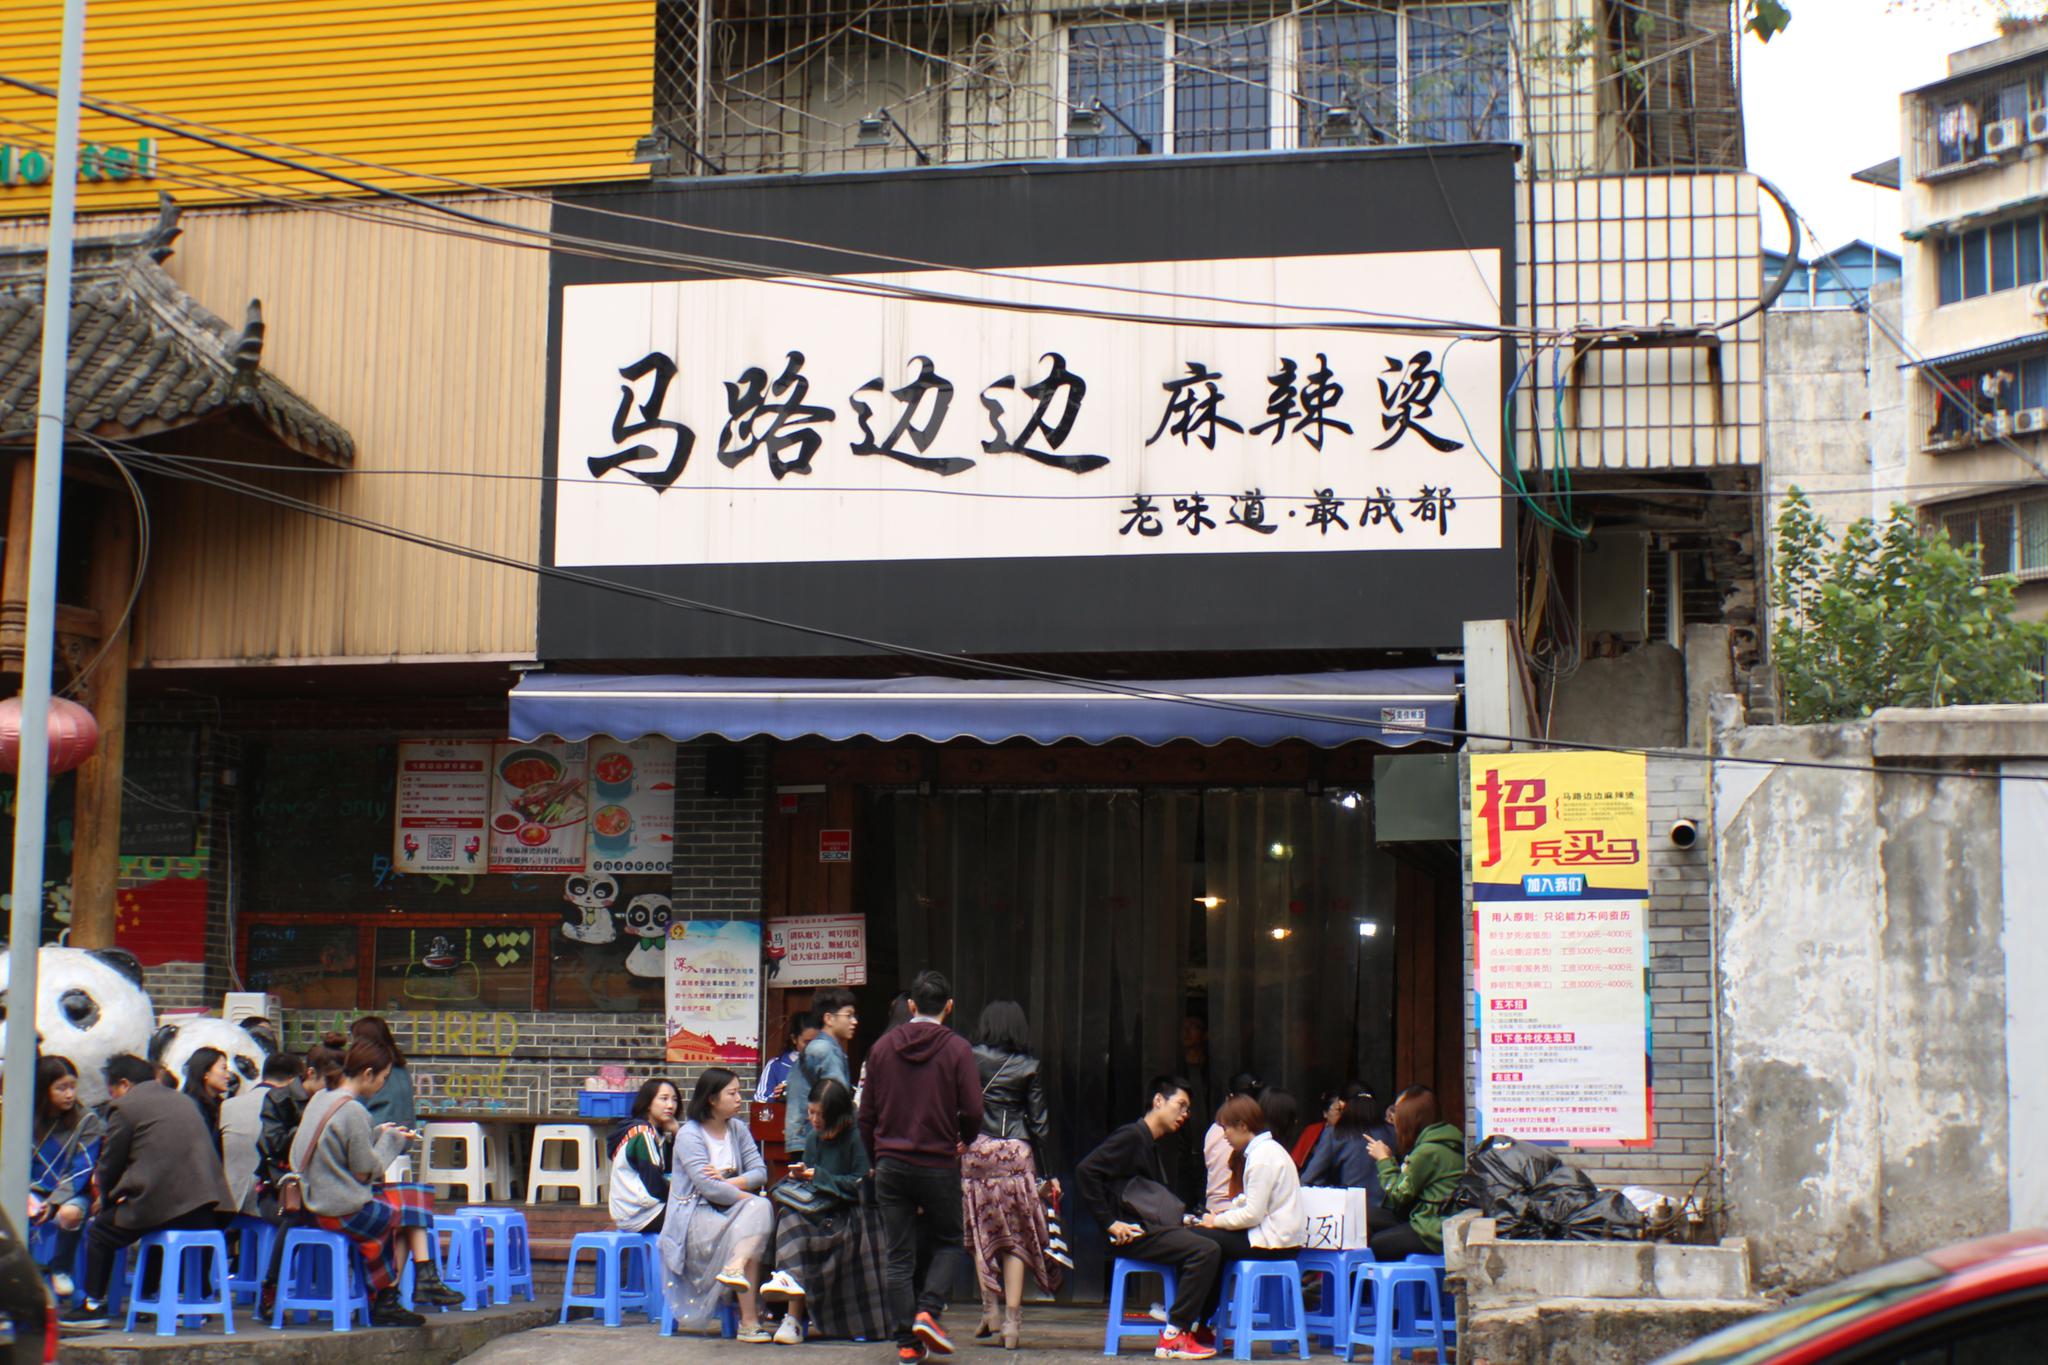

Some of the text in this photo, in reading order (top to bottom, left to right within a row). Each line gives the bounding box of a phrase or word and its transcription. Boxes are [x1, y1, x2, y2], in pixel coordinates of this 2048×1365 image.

[586, 350, 1464, 494] 马路边边 麻辣烫
[1118, 485, 1457, 537] 老味道·最成都
[1563, 791, 1635, 801] 马路边边麻辣烫
[1527, 877, 1583, 893] 加入我们
[1494, 1000, 1524, 1010] 五不招
[407, 1010, 519, 1056] TIRED
[1494, 1033, 1573, 1043] 以下条件优先录取
